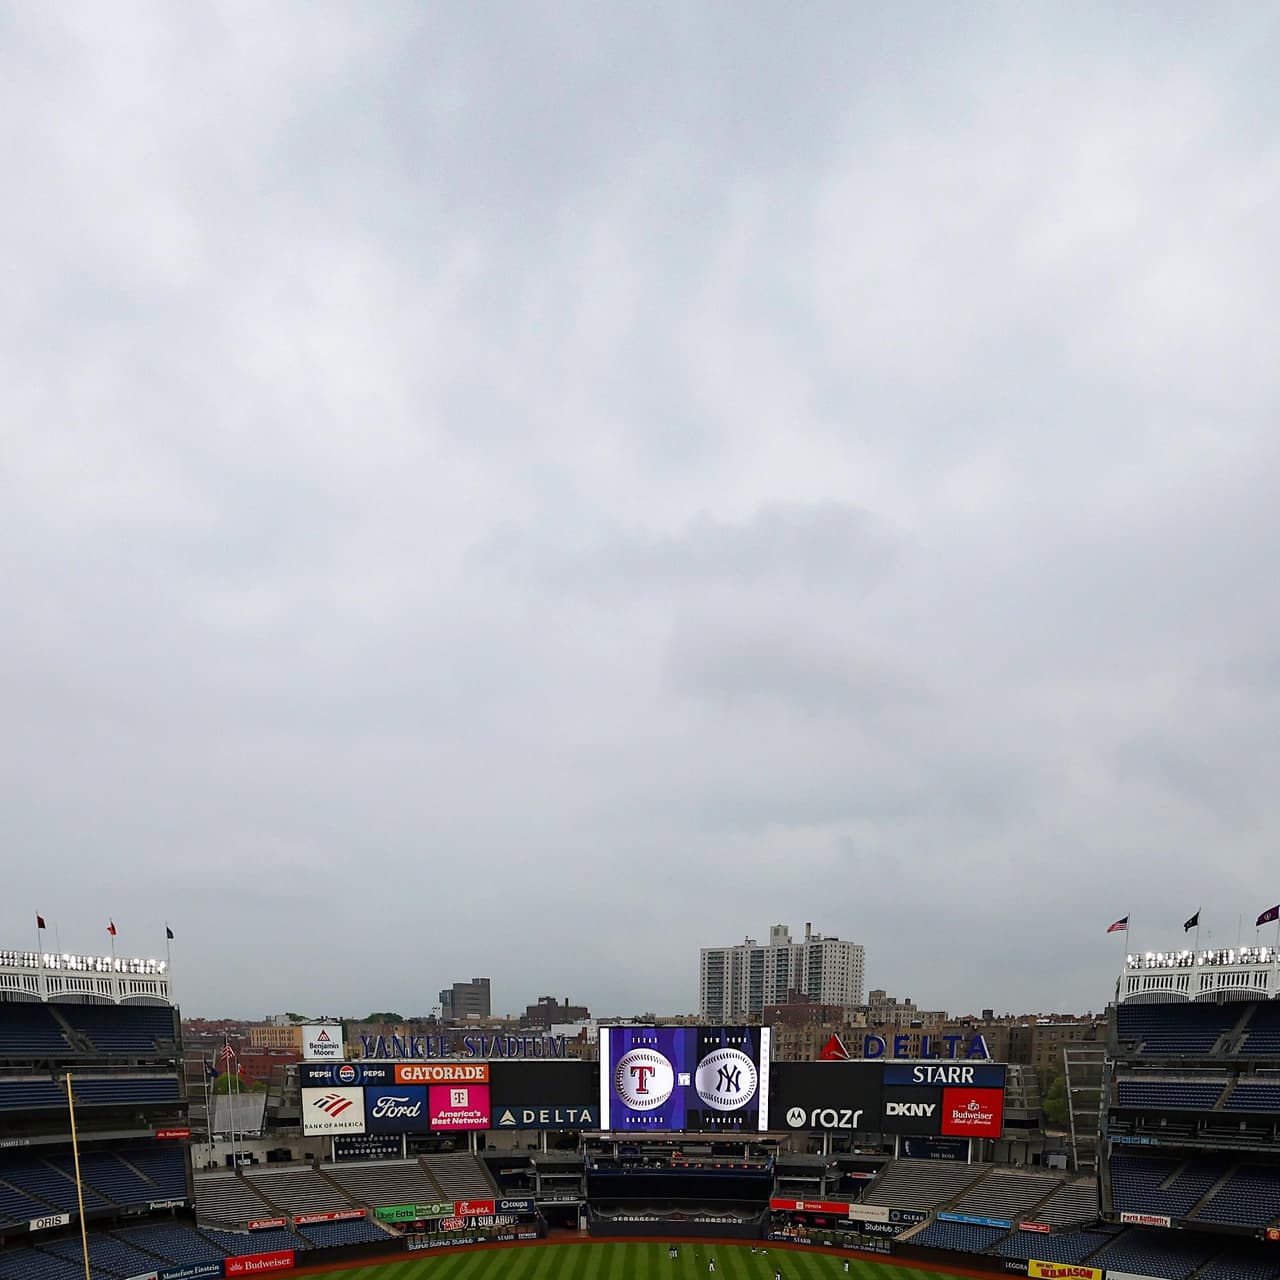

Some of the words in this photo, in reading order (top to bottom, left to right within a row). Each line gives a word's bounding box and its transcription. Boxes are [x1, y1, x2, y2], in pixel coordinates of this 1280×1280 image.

[309, 1042, 339, 1051] Benjamin
[360, 1035, 450, 1058] YANKEE
[464, 1035, 568, 1058] STADIUM
[864, 1034, 991, 1059] DELTA
[400, 1066, 485, 1081] GATORADE
[630, 1066, 655, 1094] T
[716, 1064, 742, 1093] NY
[913, 1066, 974, 1083] STARR
[372, 1096, 421, 1118] Ford
[886, 1102, 936, 1117] DKNY
[431, 1117, 451, 1125] Best
[452, 1116, 489, 1124] Network
[438, 1110, 481, 1118] America's
[523, 1109, 593, 1124] DELTA
[810, 1108, 863, 1129] razr
[952, 1110, 993, 1120] Budweiser
[509, 1201, 528, 1209] coupa
[396, 1209, 415, 1218] Eats
[1122, 1214, 1139, 1223] Parts
[1139, 1213, 1168, 1226] Authority
[36, 1215, 62, 1229] ORIS
[470, 1217, 477, 1228] A
[478, 1216, 494, 1226] SUB
[864, 1222, 893, 1233] StubHub
[195, 1263, 220, 1274] Einstein
[244, 1258, 291, 1271] Budweiser
